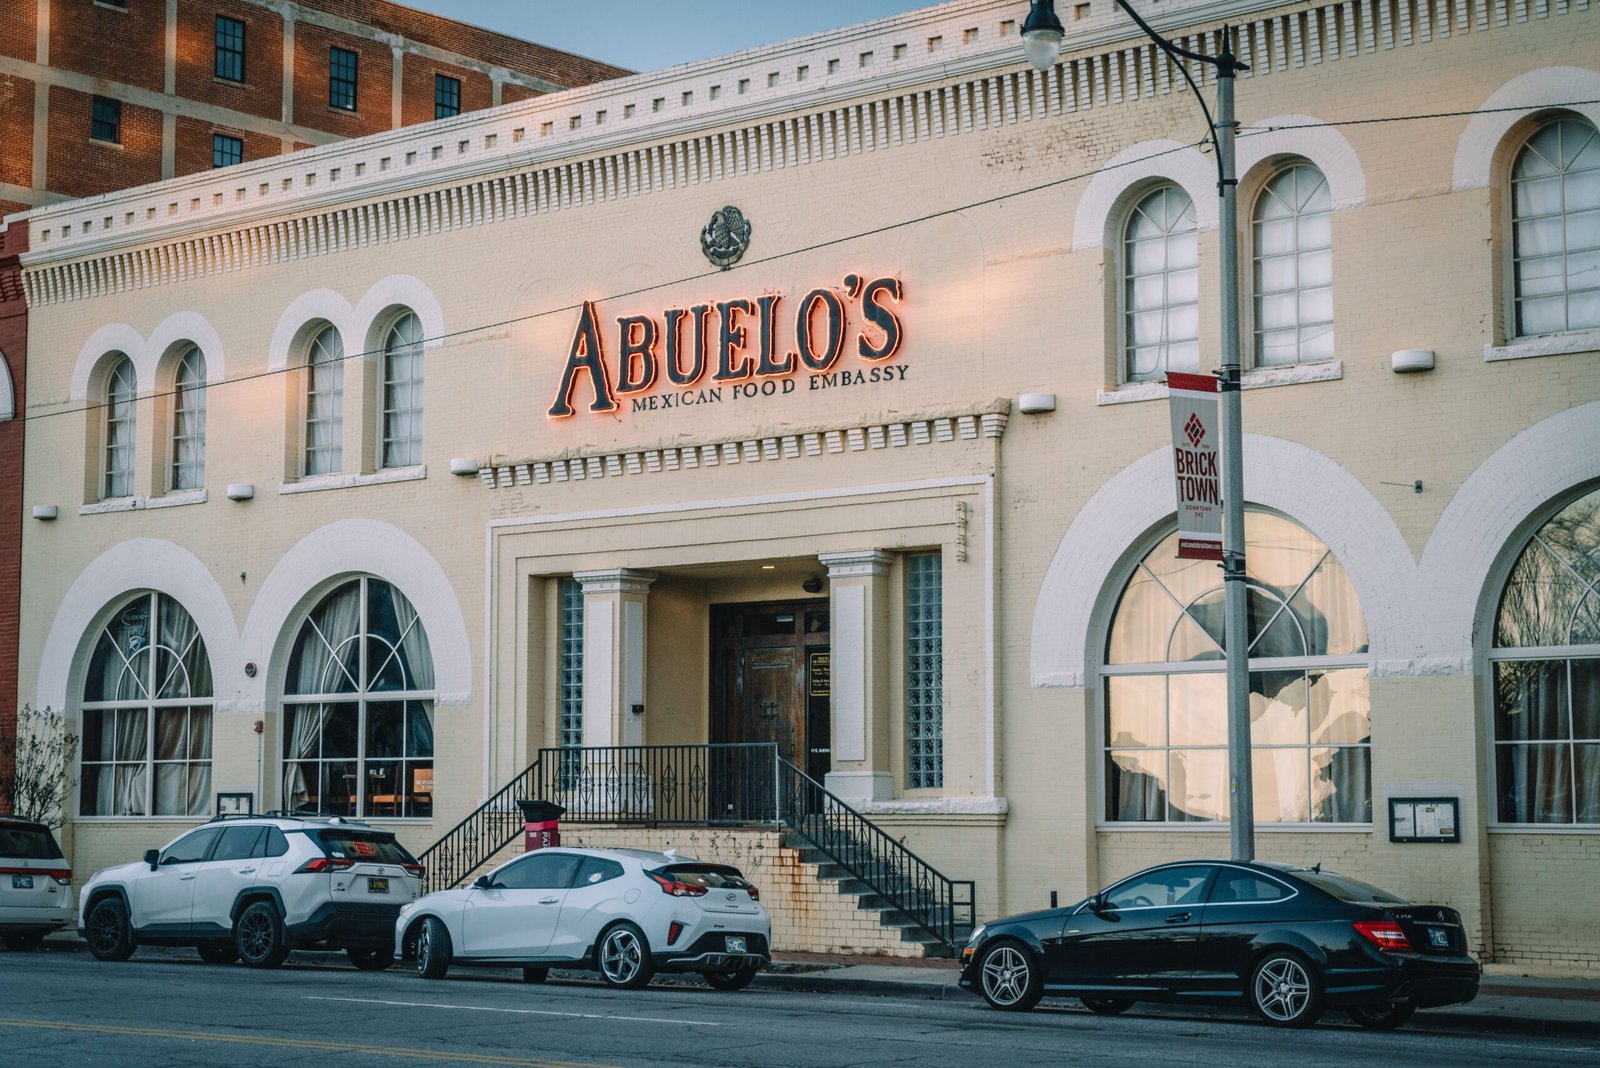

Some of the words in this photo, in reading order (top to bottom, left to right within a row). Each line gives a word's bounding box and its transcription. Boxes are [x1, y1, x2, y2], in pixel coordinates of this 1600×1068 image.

[547, 273, 903, 418] ABUELO'S
[632, 387, 722, 413] MEXICAN
[733, 378, 796, 400] FOOD
[809, 364, 910, 391] EMBASSY
[1175, 447, 1217, 477] BRICK
[1177, 475, 1219, 505] TOWN
[1185, 504, 1212, 512] DOWNTOWN
